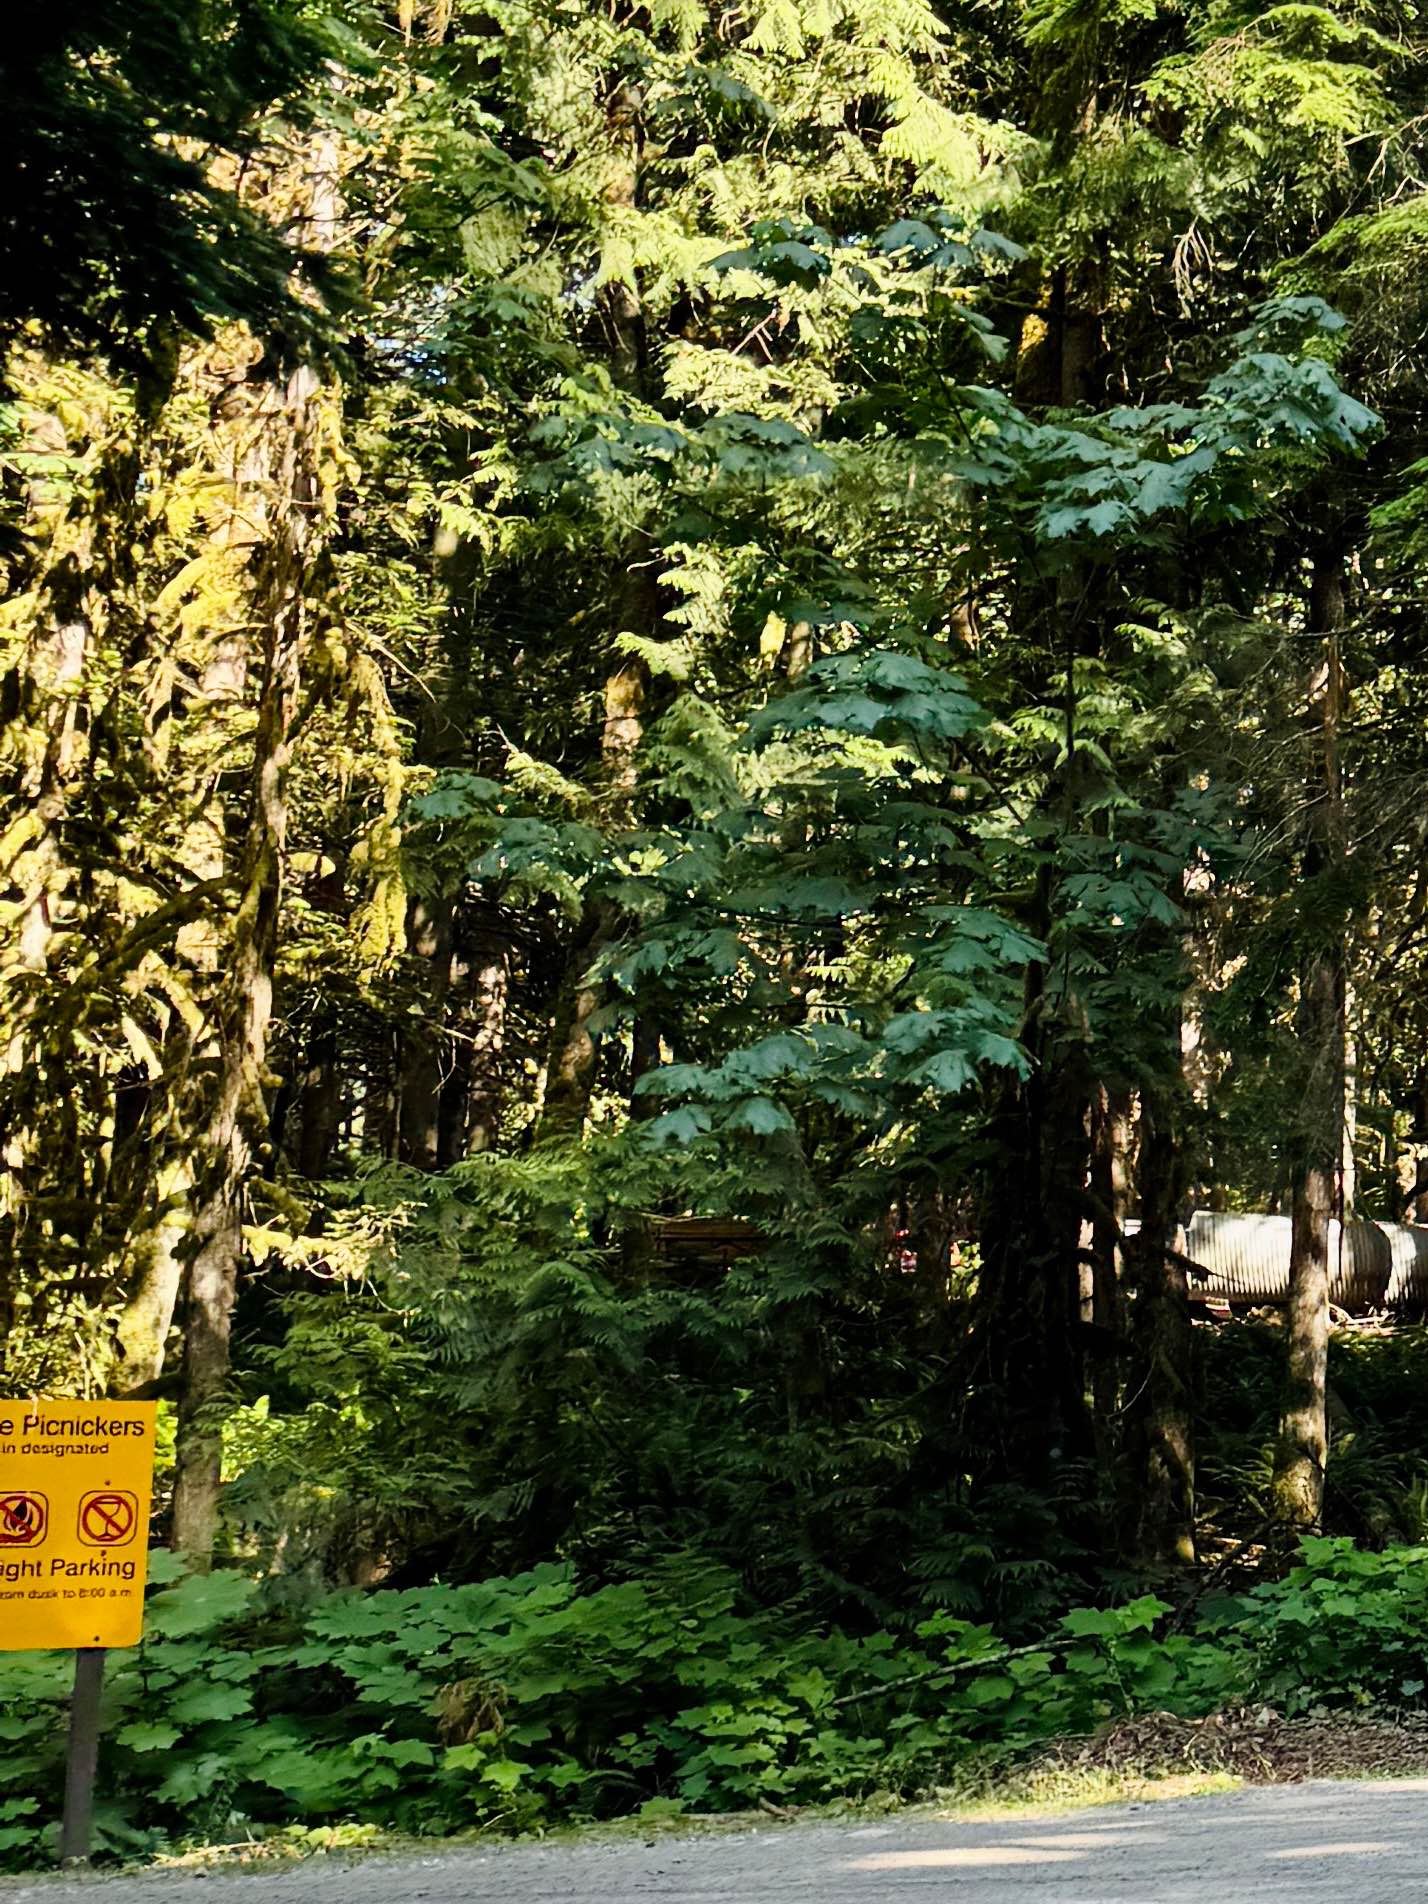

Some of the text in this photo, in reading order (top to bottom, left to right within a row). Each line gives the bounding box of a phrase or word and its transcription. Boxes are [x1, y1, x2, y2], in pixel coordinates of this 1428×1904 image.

[23, 1413, 146, 1436] Picnickers
[21, 1442, 109, 1457] designated
[50, 1556, 136, 1580] Parking
